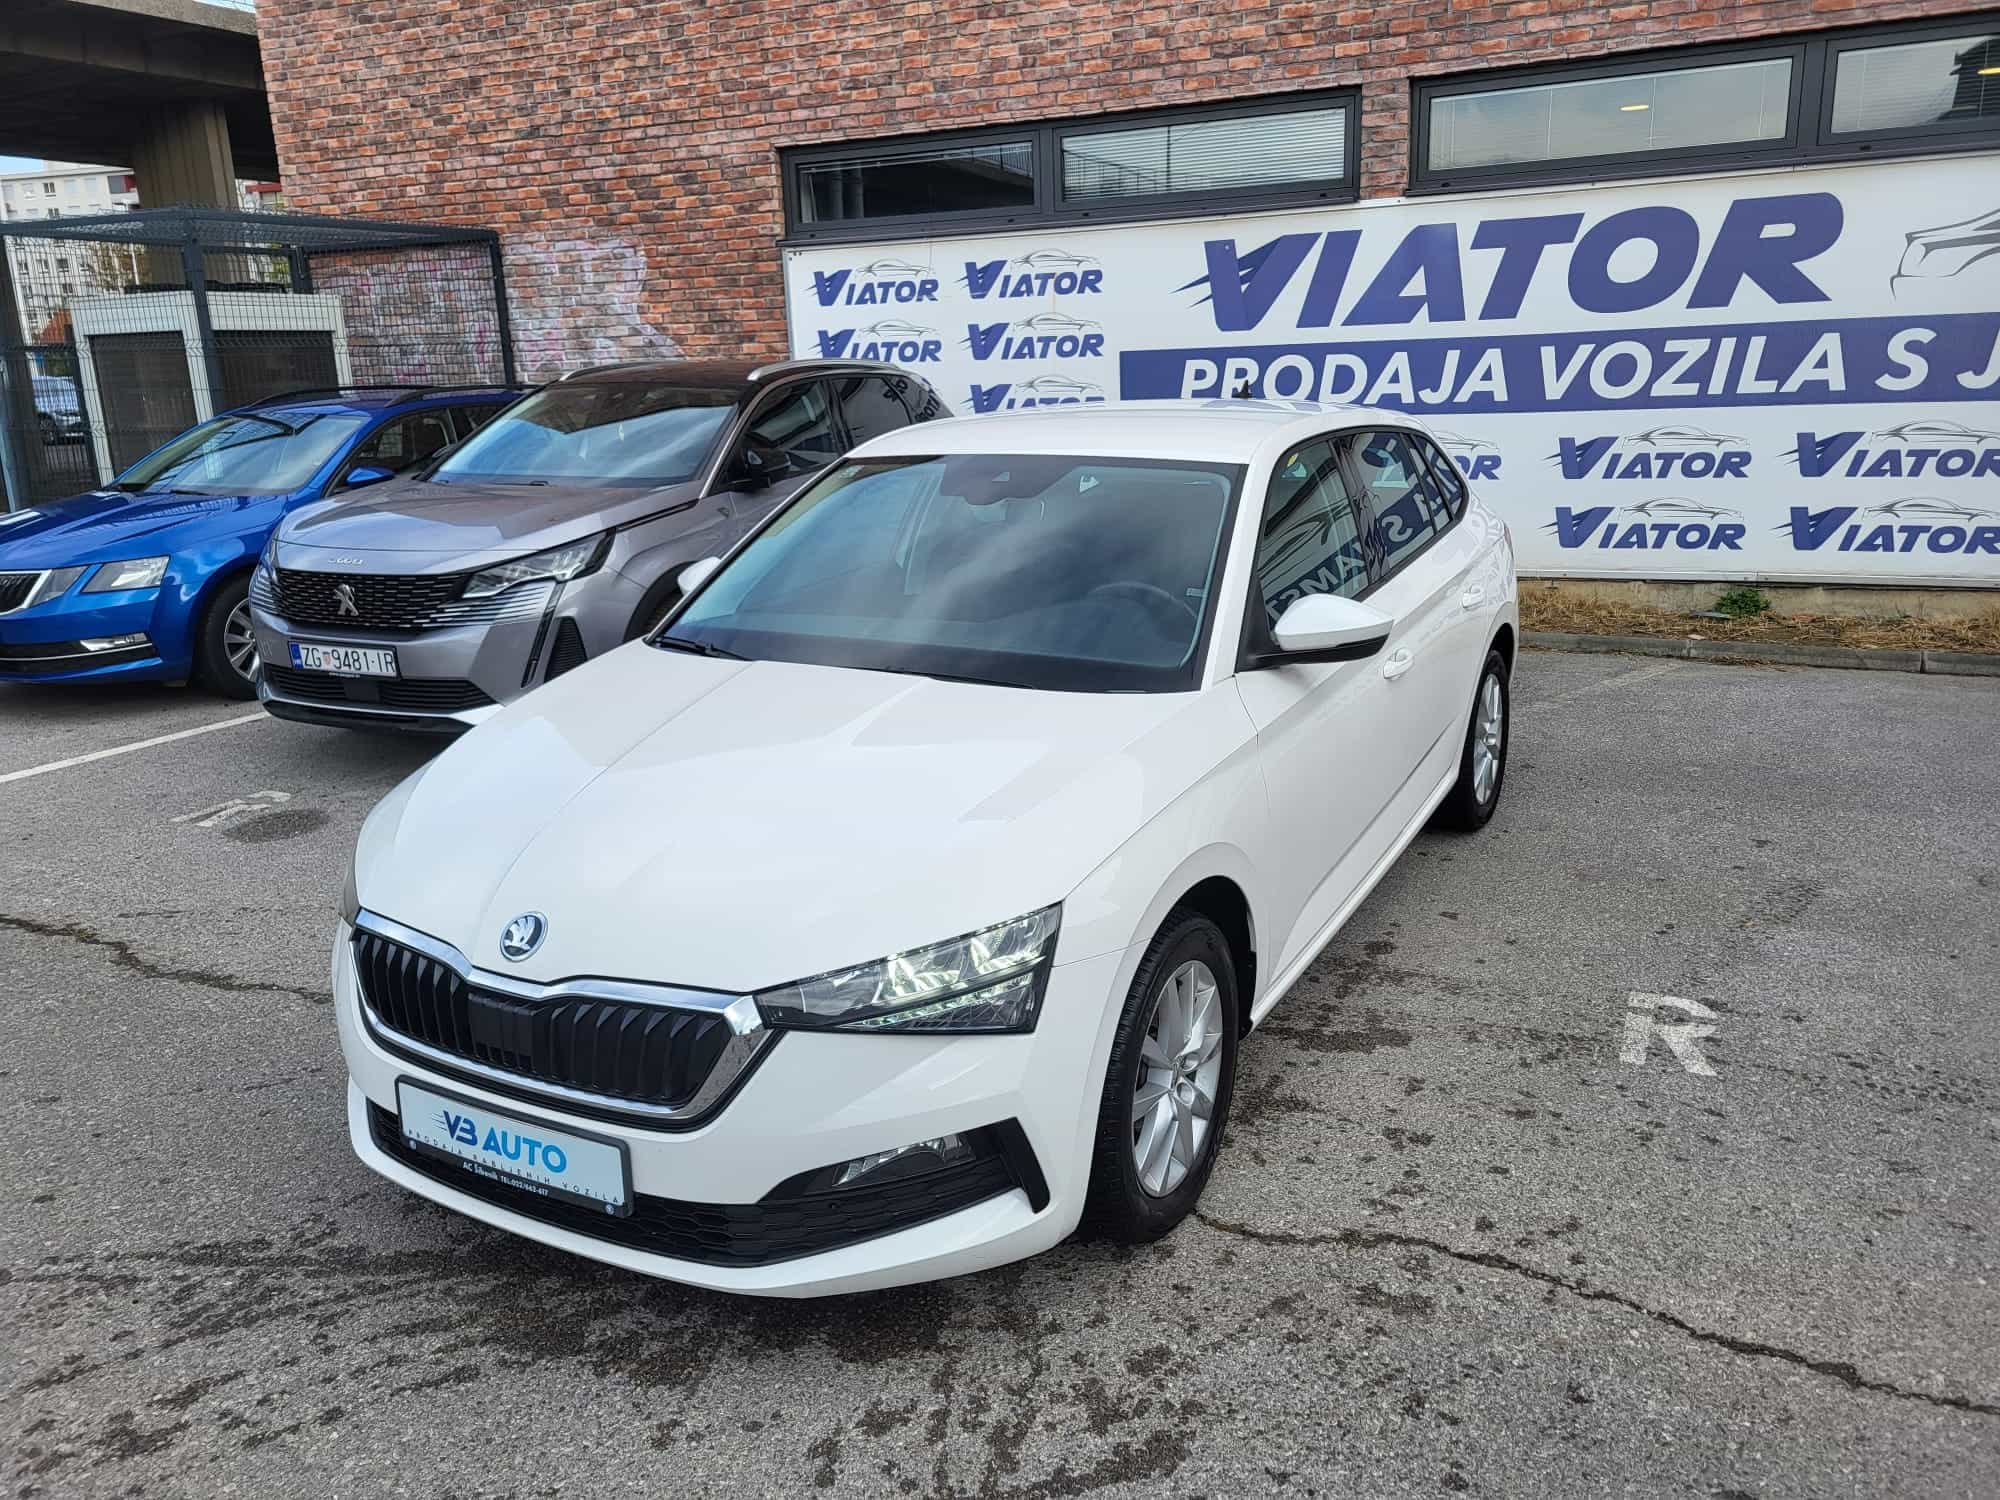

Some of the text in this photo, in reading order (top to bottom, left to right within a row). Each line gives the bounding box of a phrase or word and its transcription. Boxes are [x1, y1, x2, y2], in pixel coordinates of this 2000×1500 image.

[964, 259, 1103, 300] VIATOR
[1202, 192, 1844, 332] VIATOR
[812, 269, 940, 307] VIATOR
[817, 329, 943, 363] VIATOR
[967, 322, 1105, 361] VIATOR
[1181, 348, 1509, 405] PRODAJA
[1540, 332, 1846, 398] VOZILA
[1874, 327, 1938, 391] S
[1558, 436, 1752, 480] VIATOR
[1797, 431, 2000, 479] VIATOR
[1554, 506, 1746, 551] VIATOR
[1789, 506, 2000, 555] VIATOR
[300, 646, 322, 669] ZG
[1619, 991, 1719, 1076] R
[482, 1127, 567, 1173] AUTO
